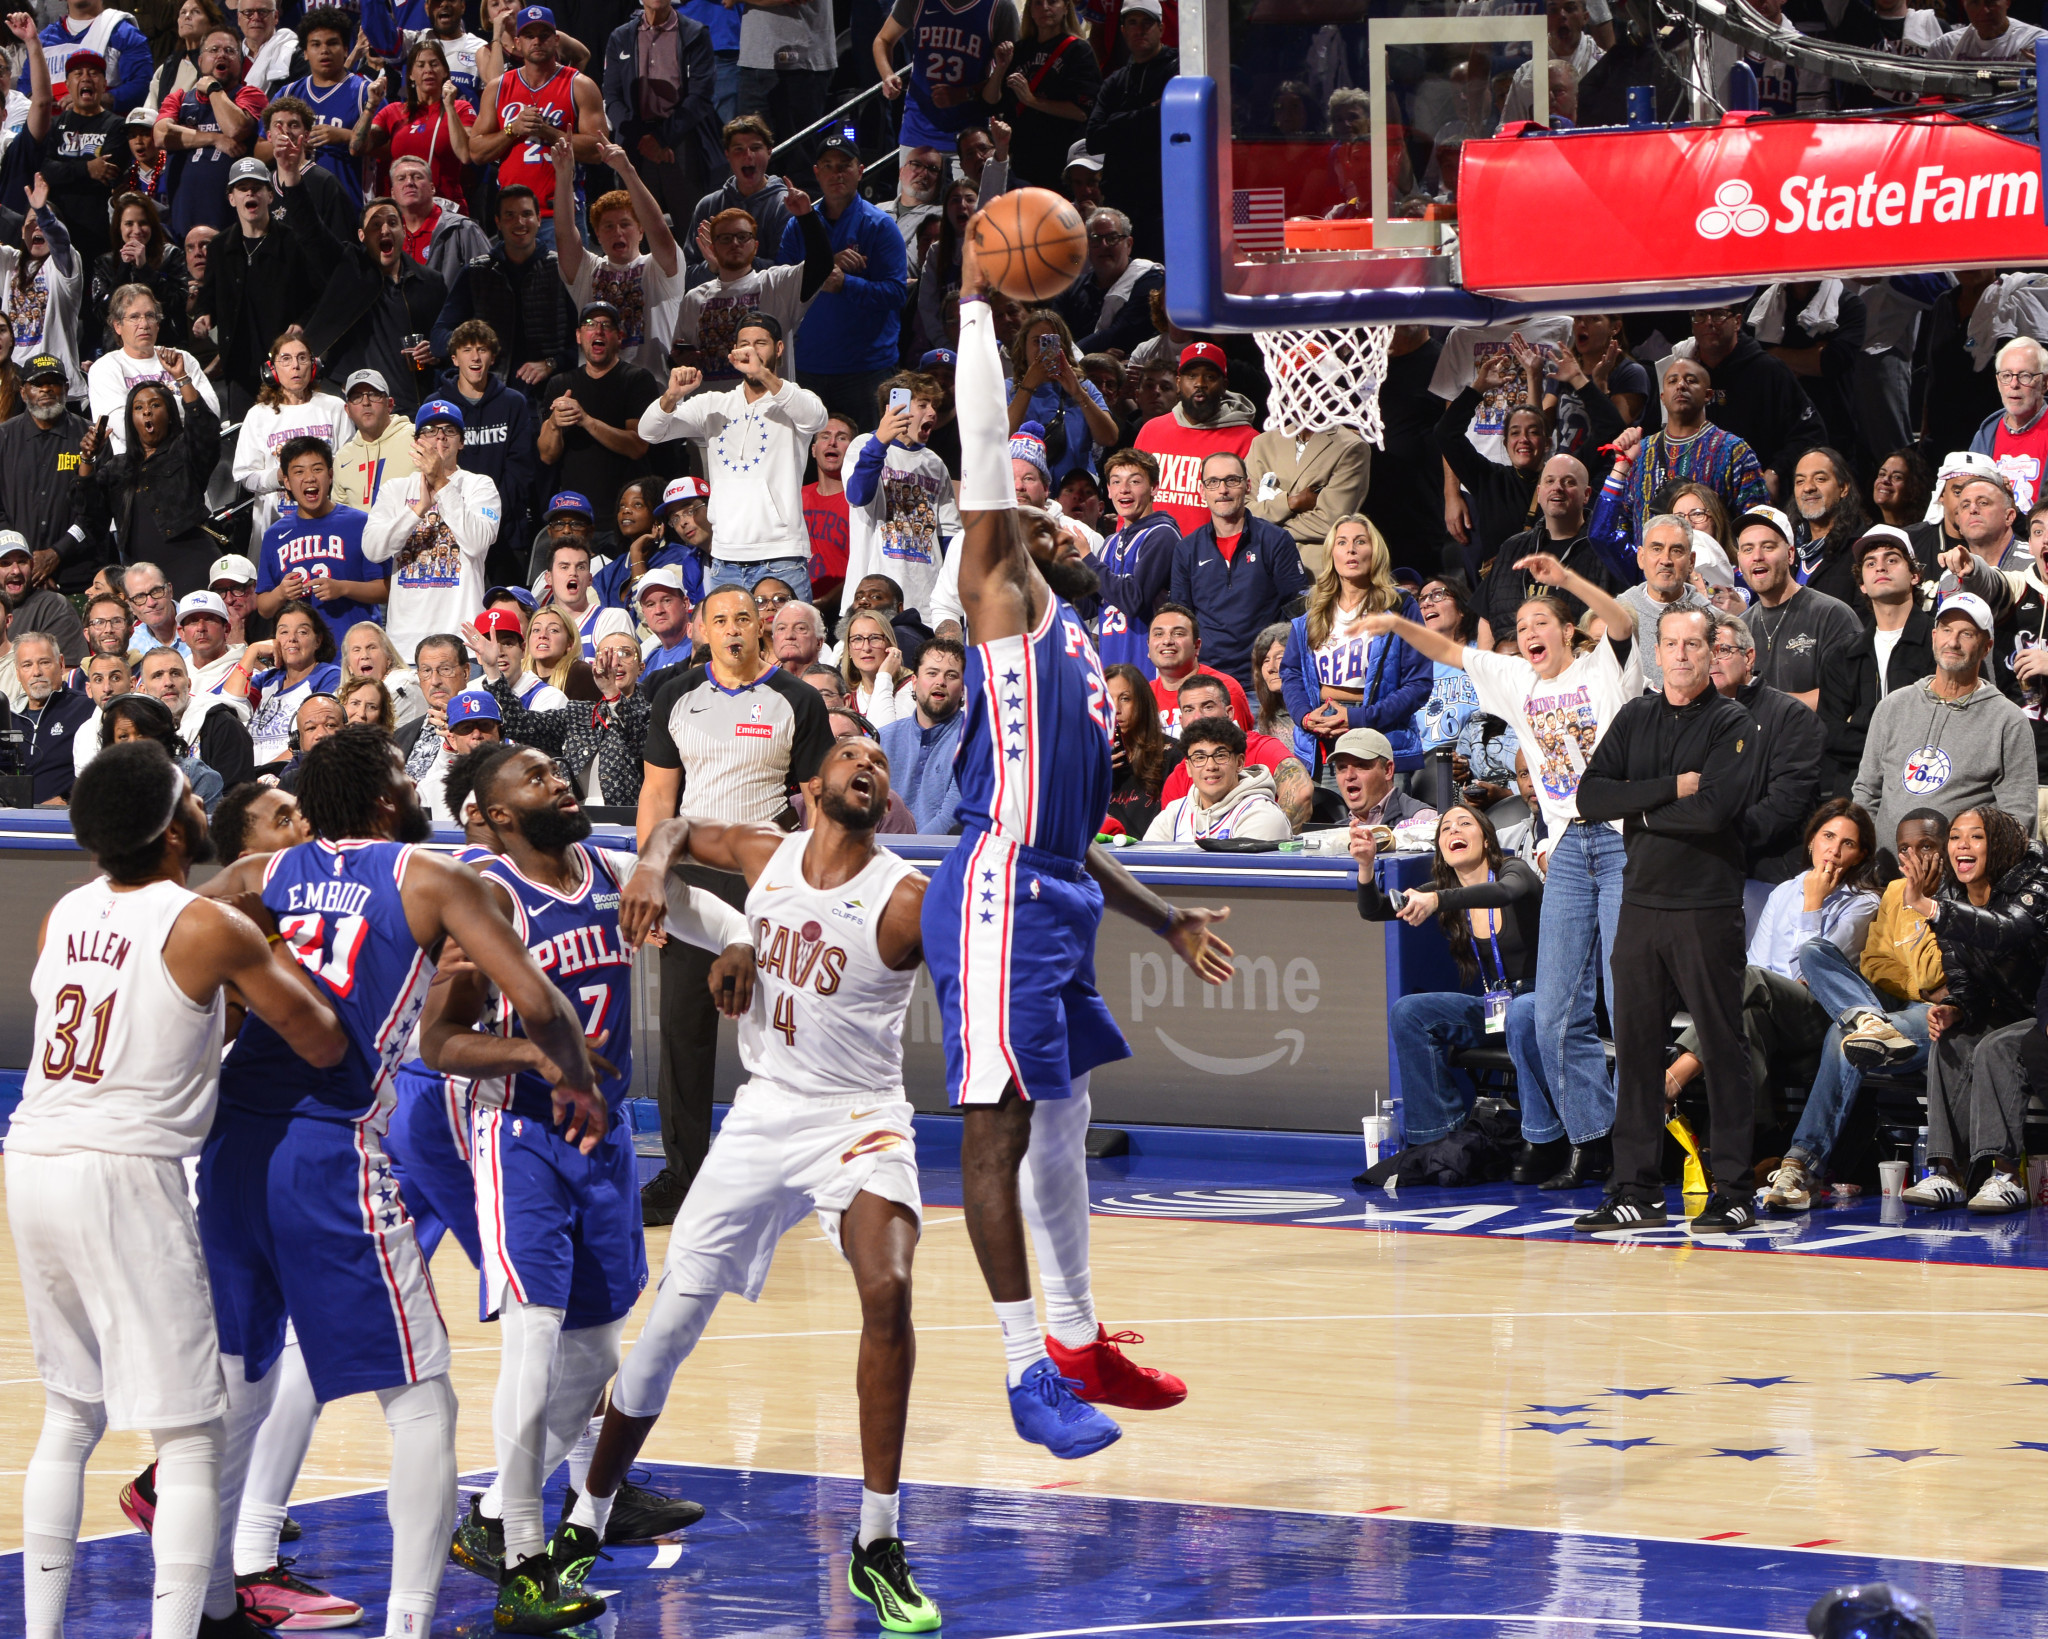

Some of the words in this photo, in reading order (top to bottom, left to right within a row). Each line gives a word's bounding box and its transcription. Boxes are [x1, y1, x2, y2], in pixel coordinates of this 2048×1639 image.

[919, 26, 982, 59] PHILA
[926, 54, 965, 83] 23
[502, 102, 566, 133] Pla
[936, 352, 950, 363] 76
[1195, 342, 1208, 355] P
[464, 425, 508, 446] RMITS
[277, 534, 345, 573] PHILA
[488, 612, 501, 627] P
[1101, 605, 1127, 635] 23
[463, 699, 481, 714] 76
[737, 725, 772, 736] Emirates
[1906, 762, 1944, 785] 76ers
[1110, 790, 1140, 808] ladelphia
[288, 882, 372, 916] EMBIID
[592, 892, 621, 904] Bloom
[595, 900, 620, 911] energ
[831, 908, 864, 926] CLIFFS
[67, 930, 132, 971] ALLEN
[279, 912, 369, 999] 21
[756, 917, 847, 996] CAVS
[1129, 951, 1321, 1022] prime
[579, 983, 610, 1038] 7
[773, 990, 796, 1047] 4
[42, 983, 118, 1085] 31
